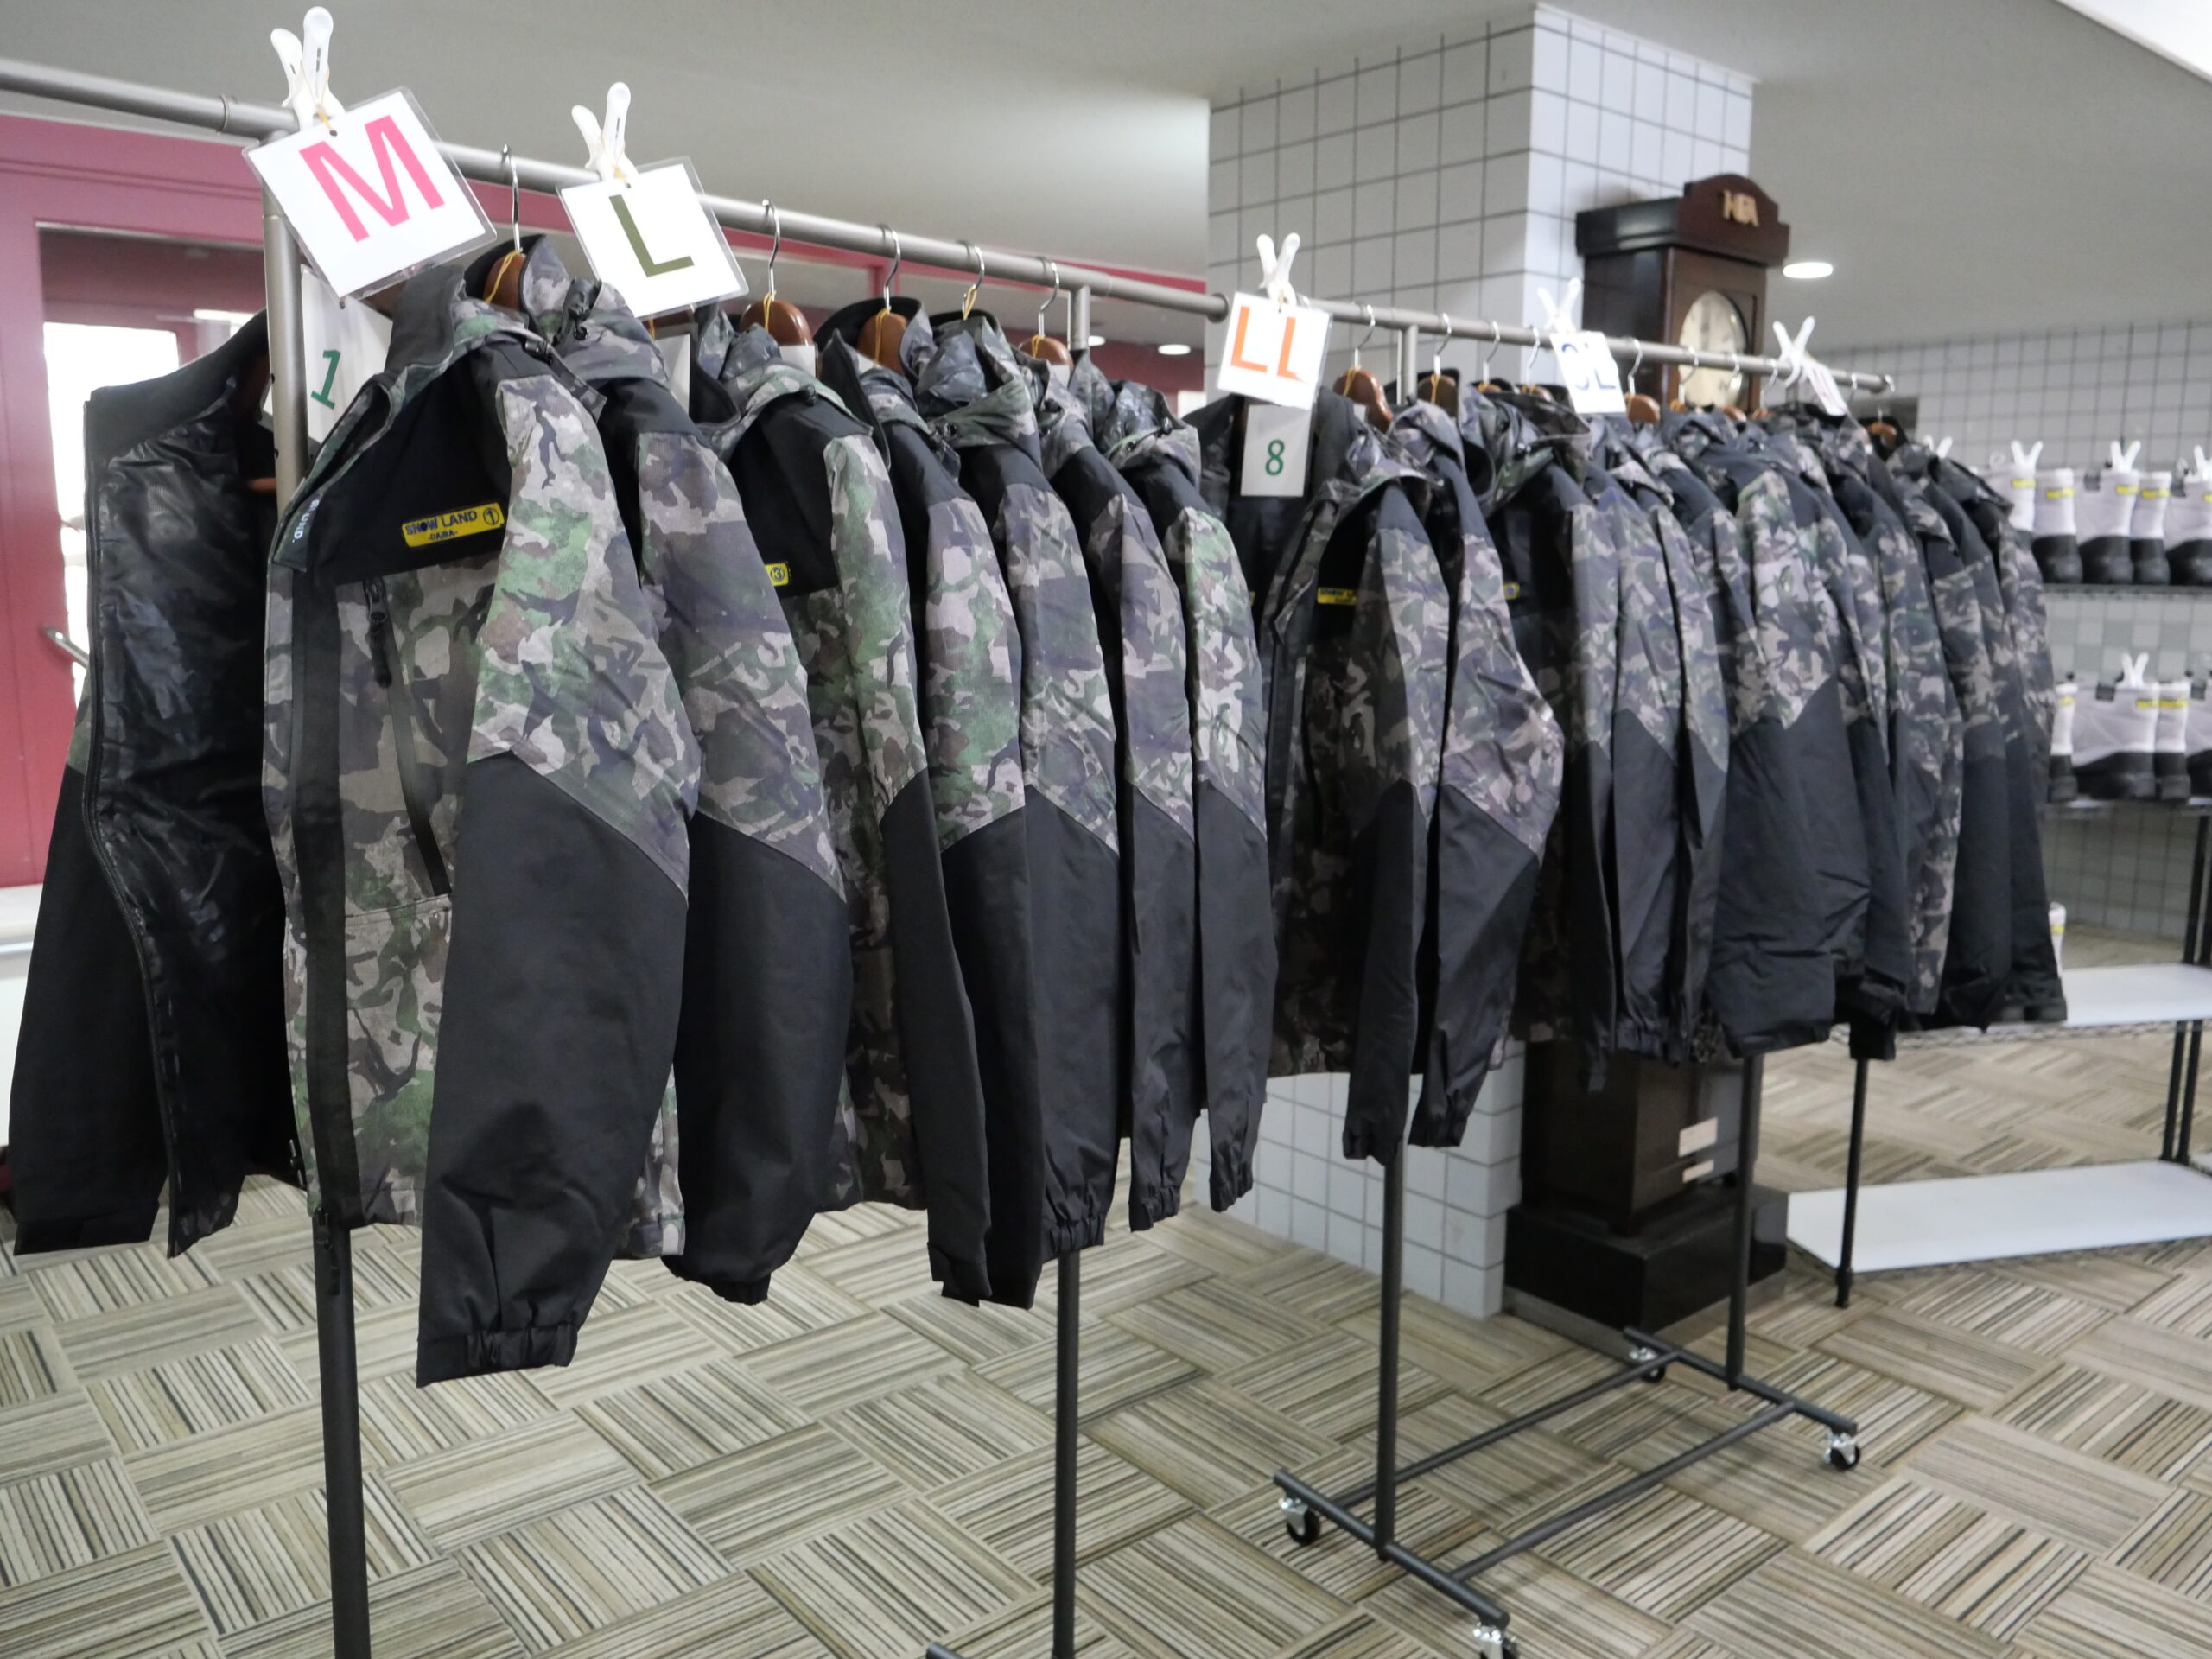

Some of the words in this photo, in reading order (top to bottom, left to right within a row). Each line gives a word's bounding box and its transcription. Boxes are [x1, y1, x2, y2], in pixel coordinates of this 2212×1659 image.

[299, 115, 445, 243] M
[608, 194, 695, 277] L
[311, 349, 341, 410] 1
[1230, 306, 1310, 385] LL
[1265, 439, 1285, 476] 8
[406, 518, 438, 536] SNOW
[442, 510, 478, 528] LAND
